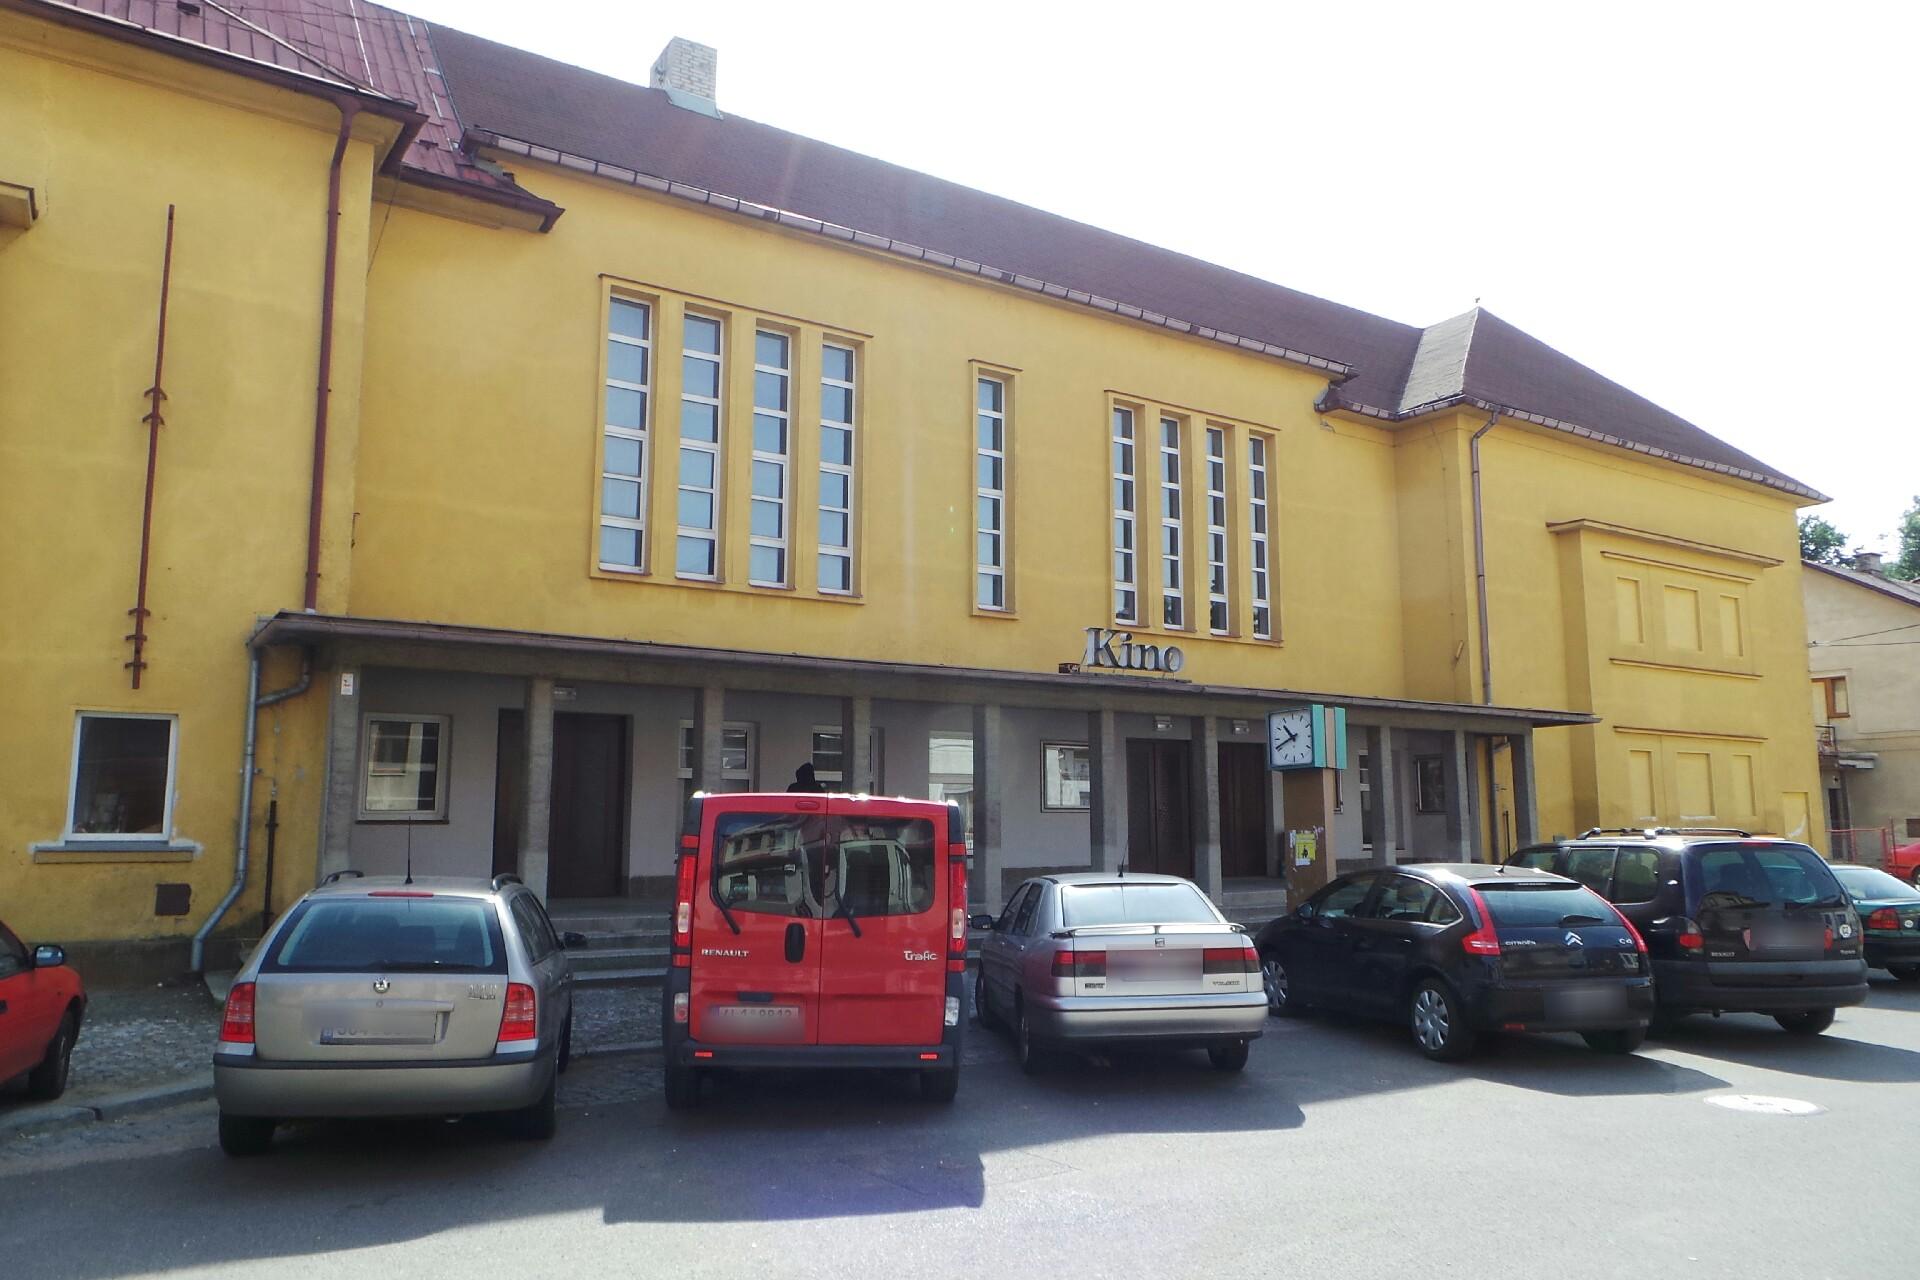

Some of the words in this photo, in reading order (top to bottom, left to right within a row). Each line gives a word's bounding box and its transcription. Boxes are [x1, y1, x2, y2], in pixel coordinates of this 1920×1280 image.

[1084, 628, 1184, 672] Kino
[701, 948, 749, 957] RENAULT
[903, 950, 937, 961] Trafic
